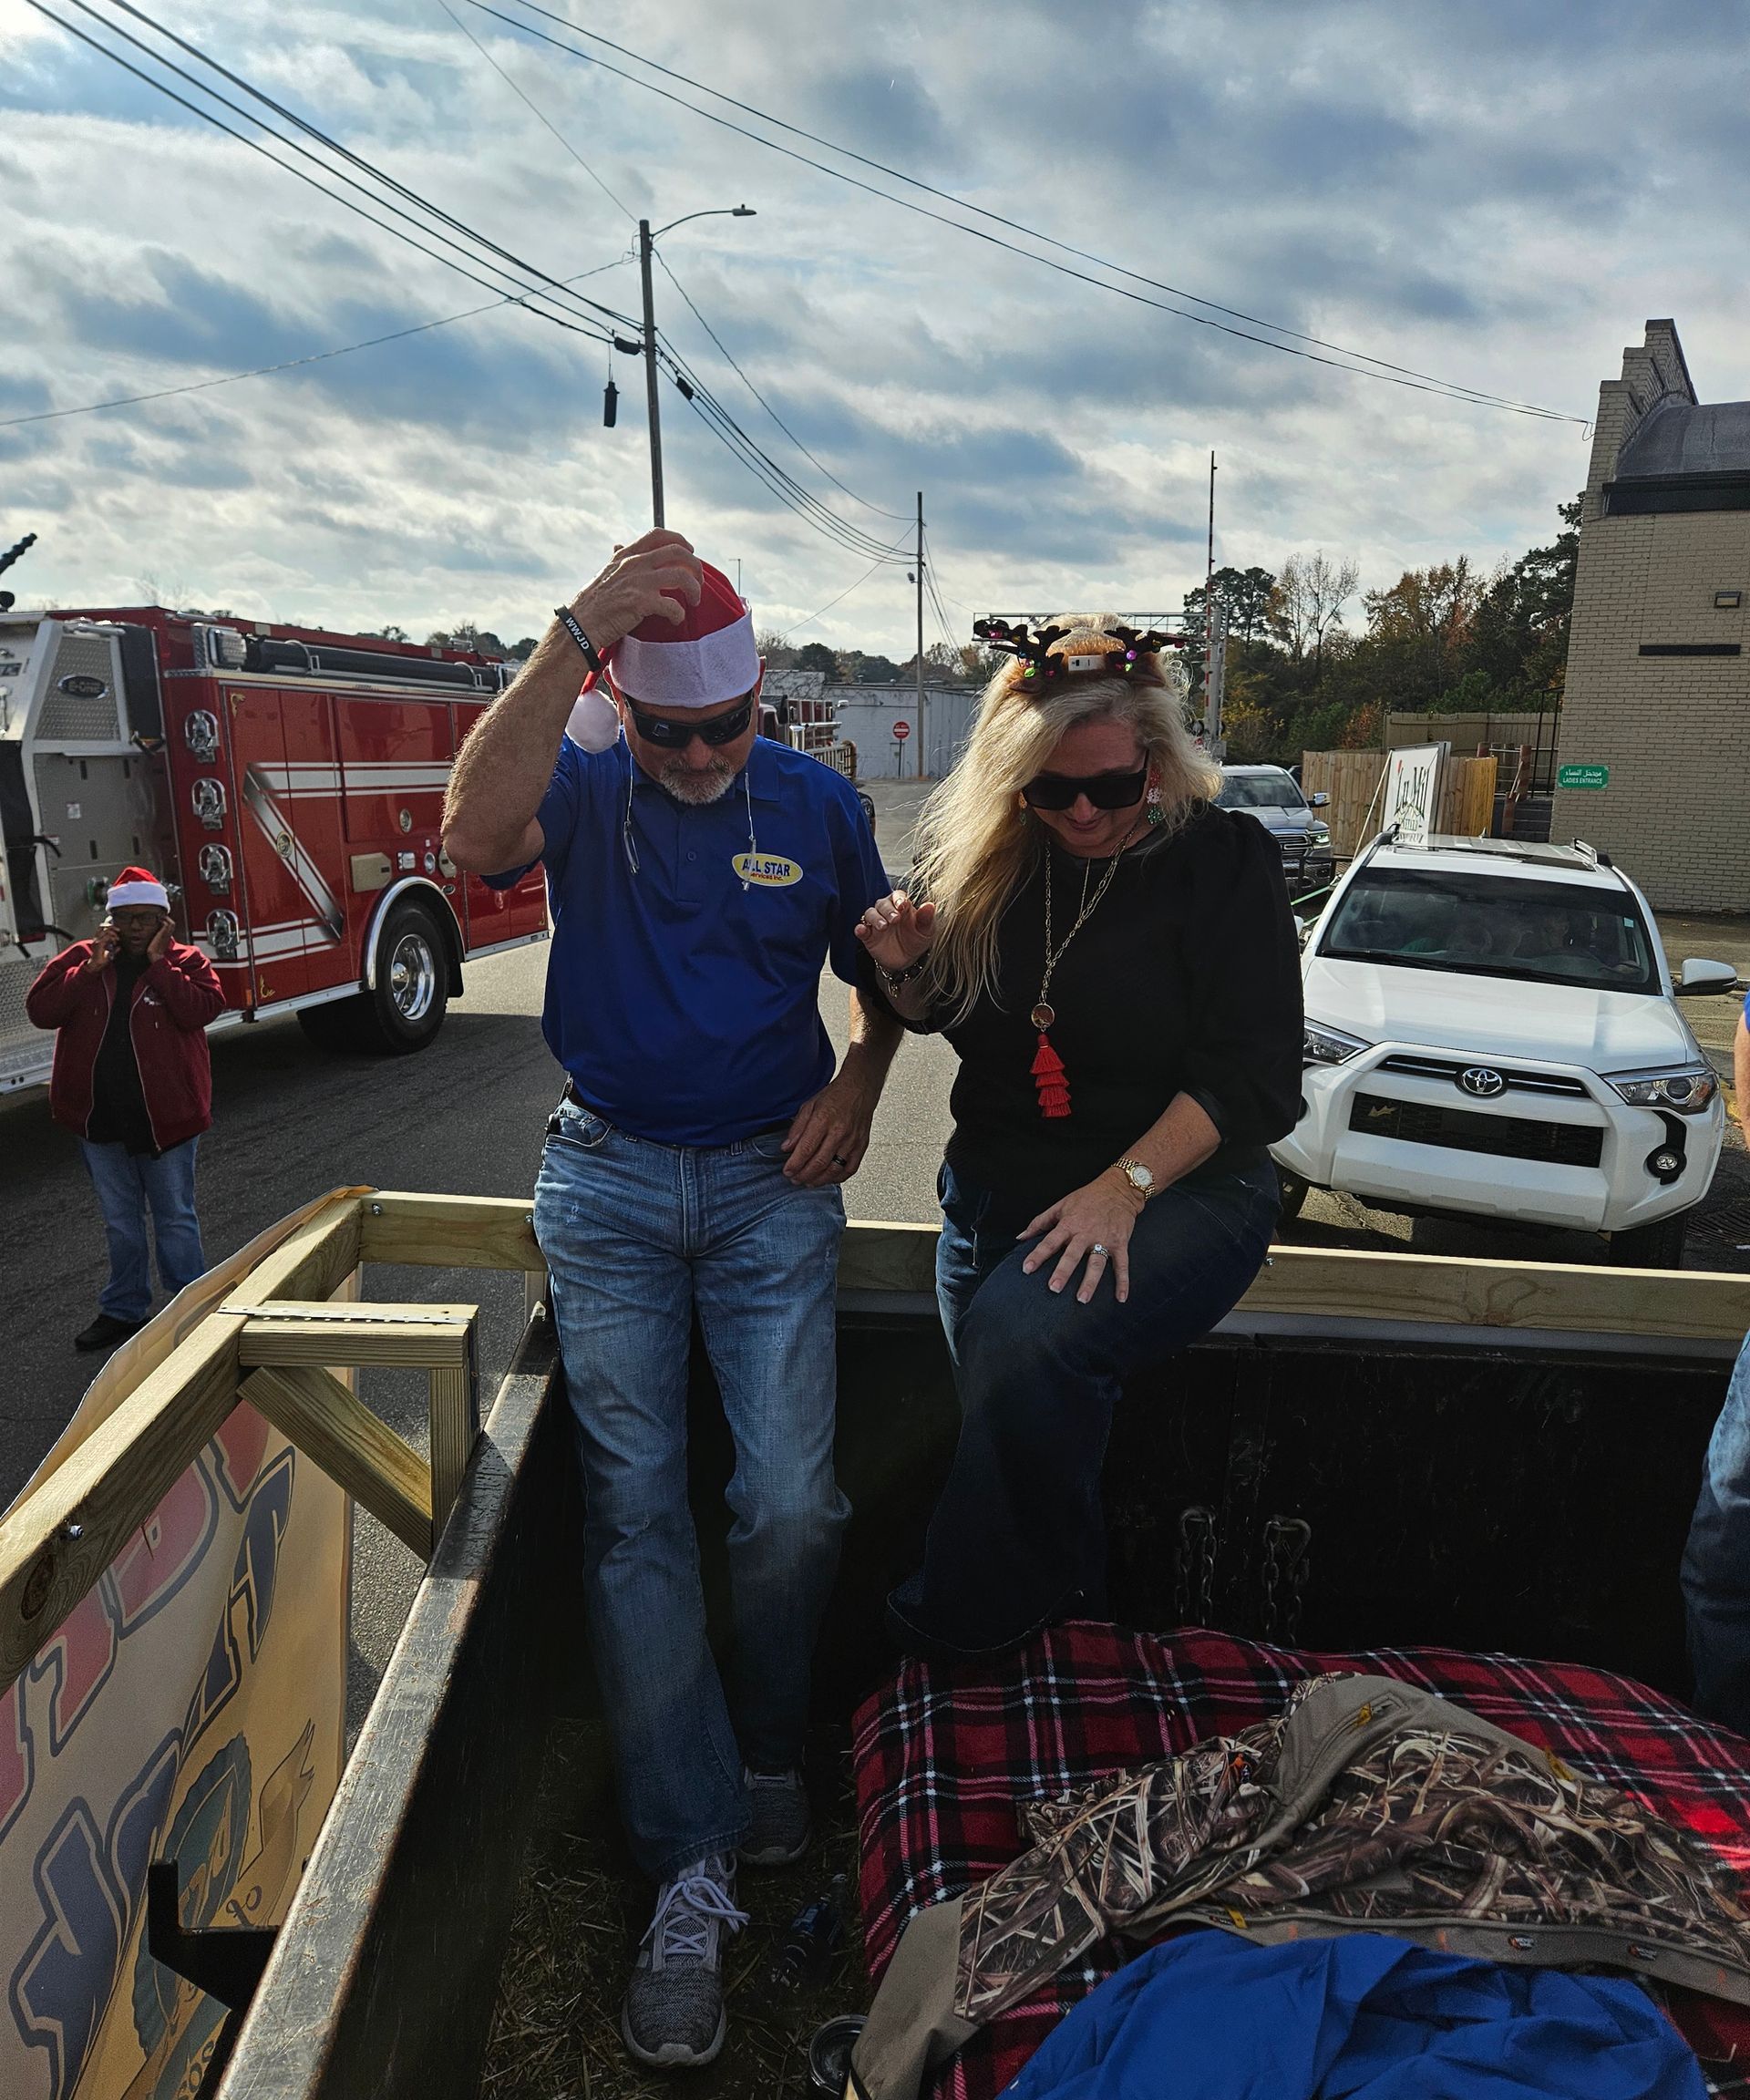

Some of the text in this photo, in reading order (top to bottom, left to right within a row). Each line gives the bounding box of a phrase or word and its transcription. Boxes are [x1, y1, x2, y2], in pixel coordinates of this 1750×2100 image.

[566, 617, 590, 650] WWJD
[1579, 777, 1602, 785] ENTRANCE
[764, 861, 790, 877] STAR
